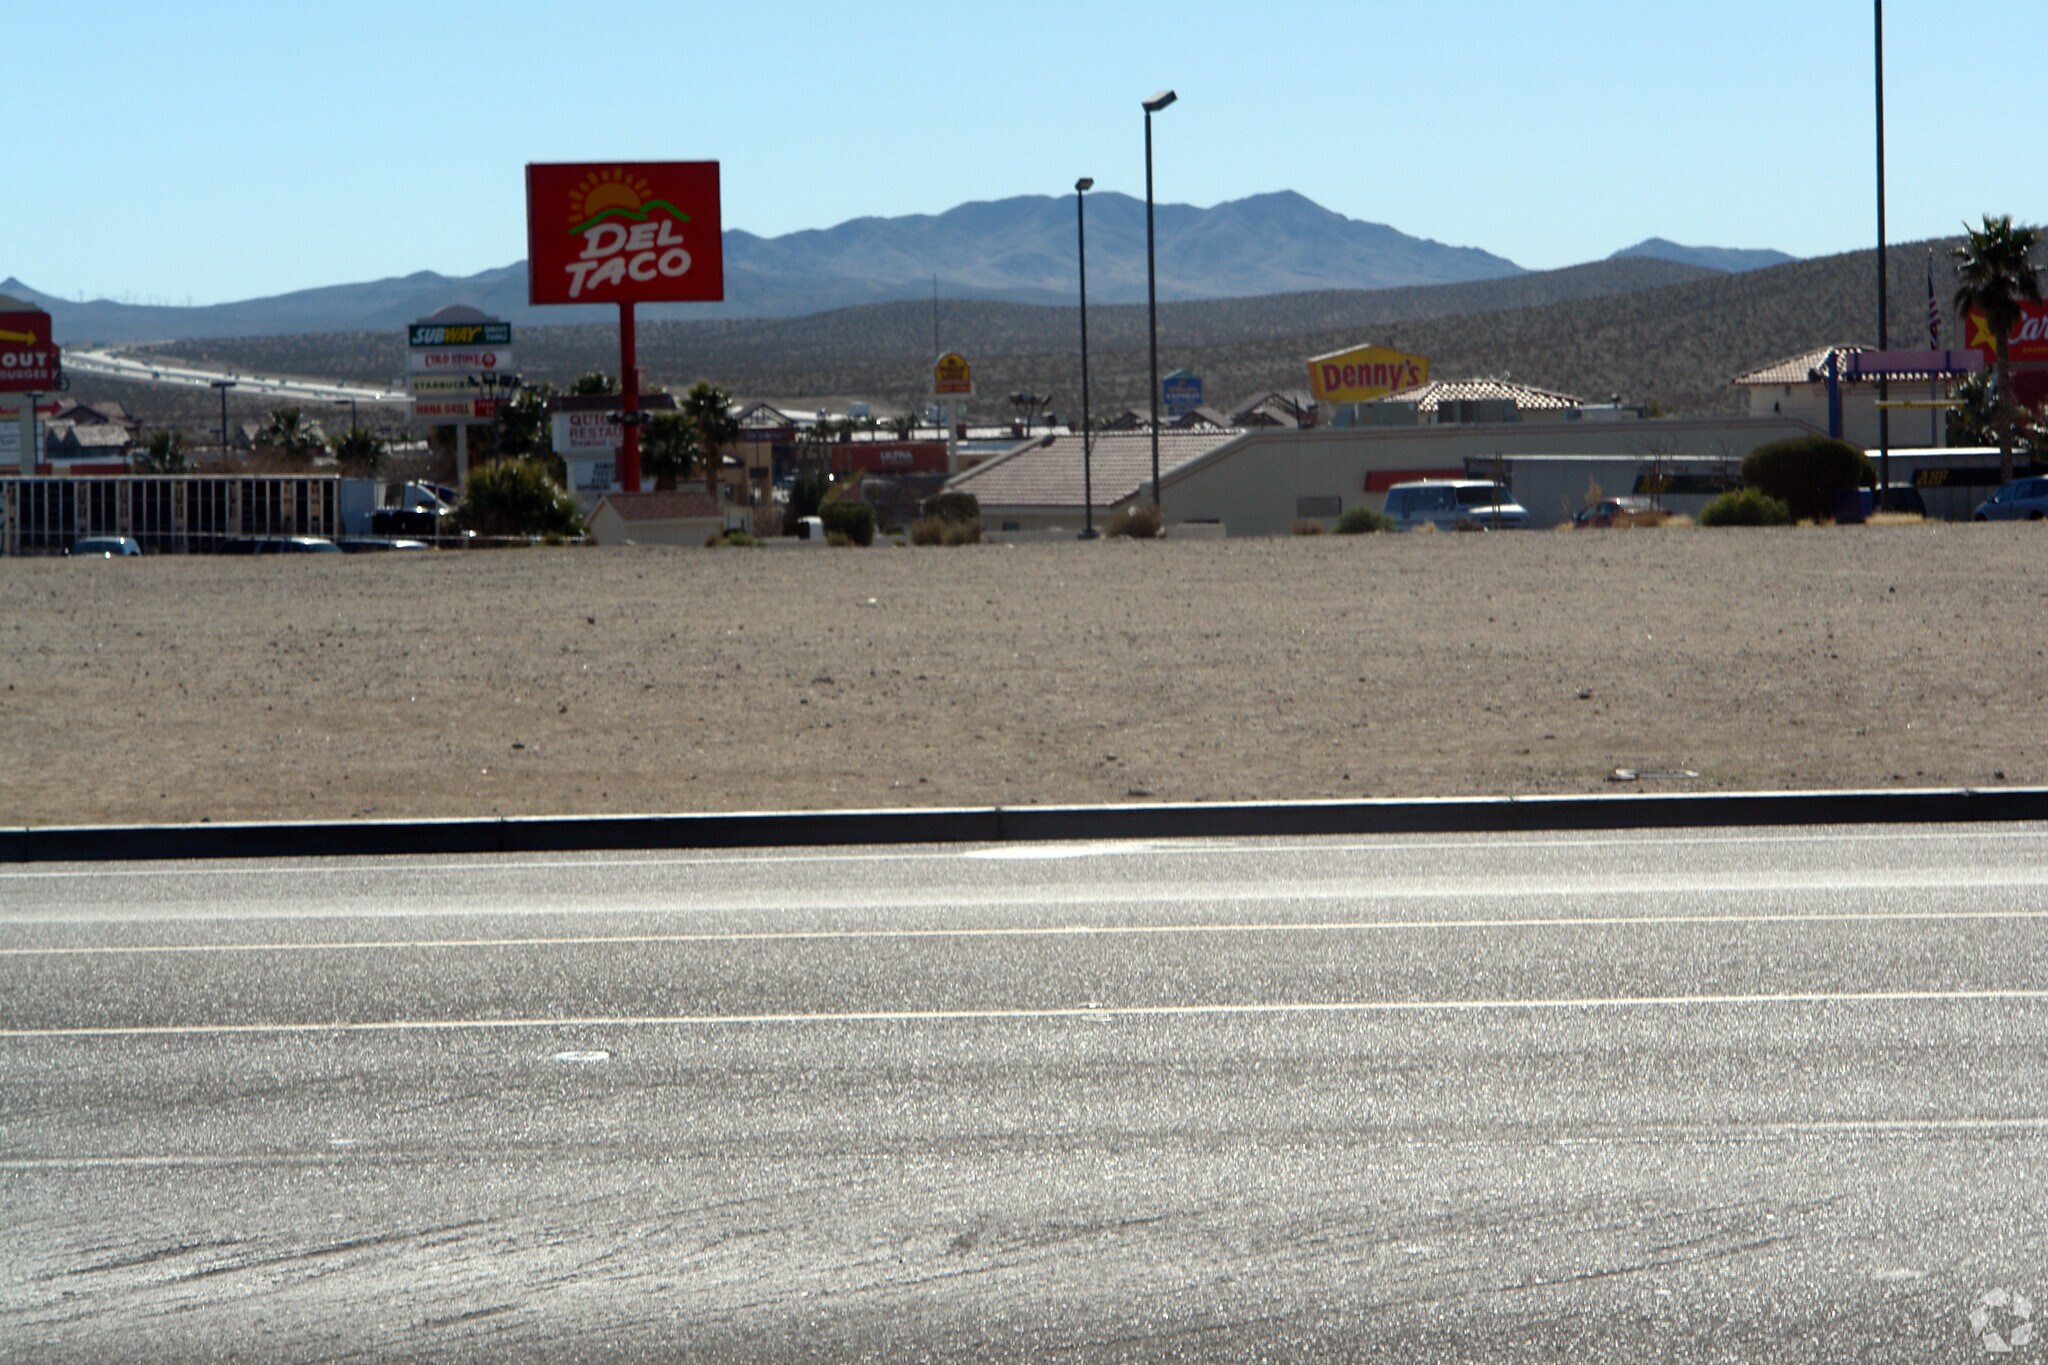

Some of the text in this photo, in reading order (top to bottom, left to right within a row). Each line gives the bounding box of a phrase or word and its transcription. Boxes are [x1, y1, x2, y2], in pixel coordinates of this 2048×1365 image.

[580, 219, 684, 259] DEL
[565, 248, 692, 298] TACO
[412, 325, 483, 344] SUBWAY
[2, 352, 48, 368] OUT
[1322, 360, 1420, 392] Denny's
[416, 403, 441, 415] HANA
[444, 402, 469, 414] GRILL
